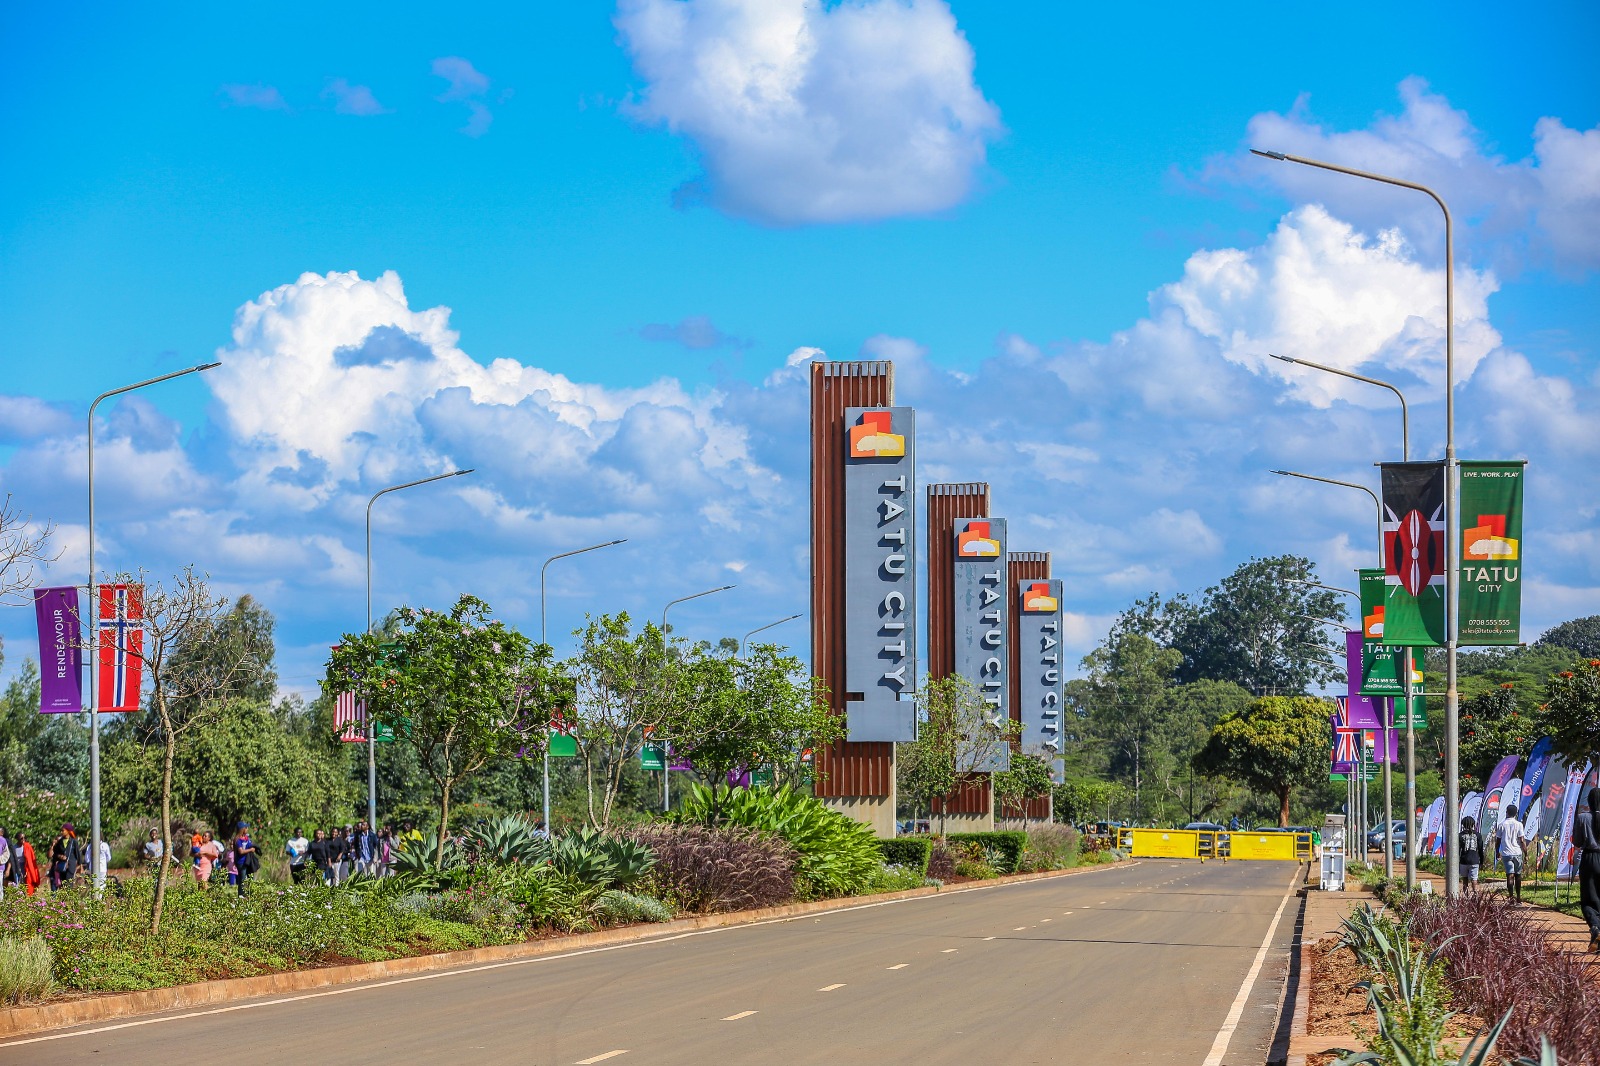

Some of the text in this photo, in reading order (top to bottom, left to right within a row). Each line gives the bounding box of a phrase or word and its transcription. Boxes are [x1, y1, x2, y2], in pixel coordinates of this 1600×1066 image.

[884, 475, 906, 686] TATU CITY
[1463, 567, 1518, 582] TATU
[1478, 584, 1502, 592] CITY
[984, 570, 1002, 645] TATU
[54, 609, 66, 678] RENDEAVOUR
[1044, 620, 1059, 750] TATU CITY
[1530, 768, 1542, 786] unity
[1545, 783, 1561, 809] grit
